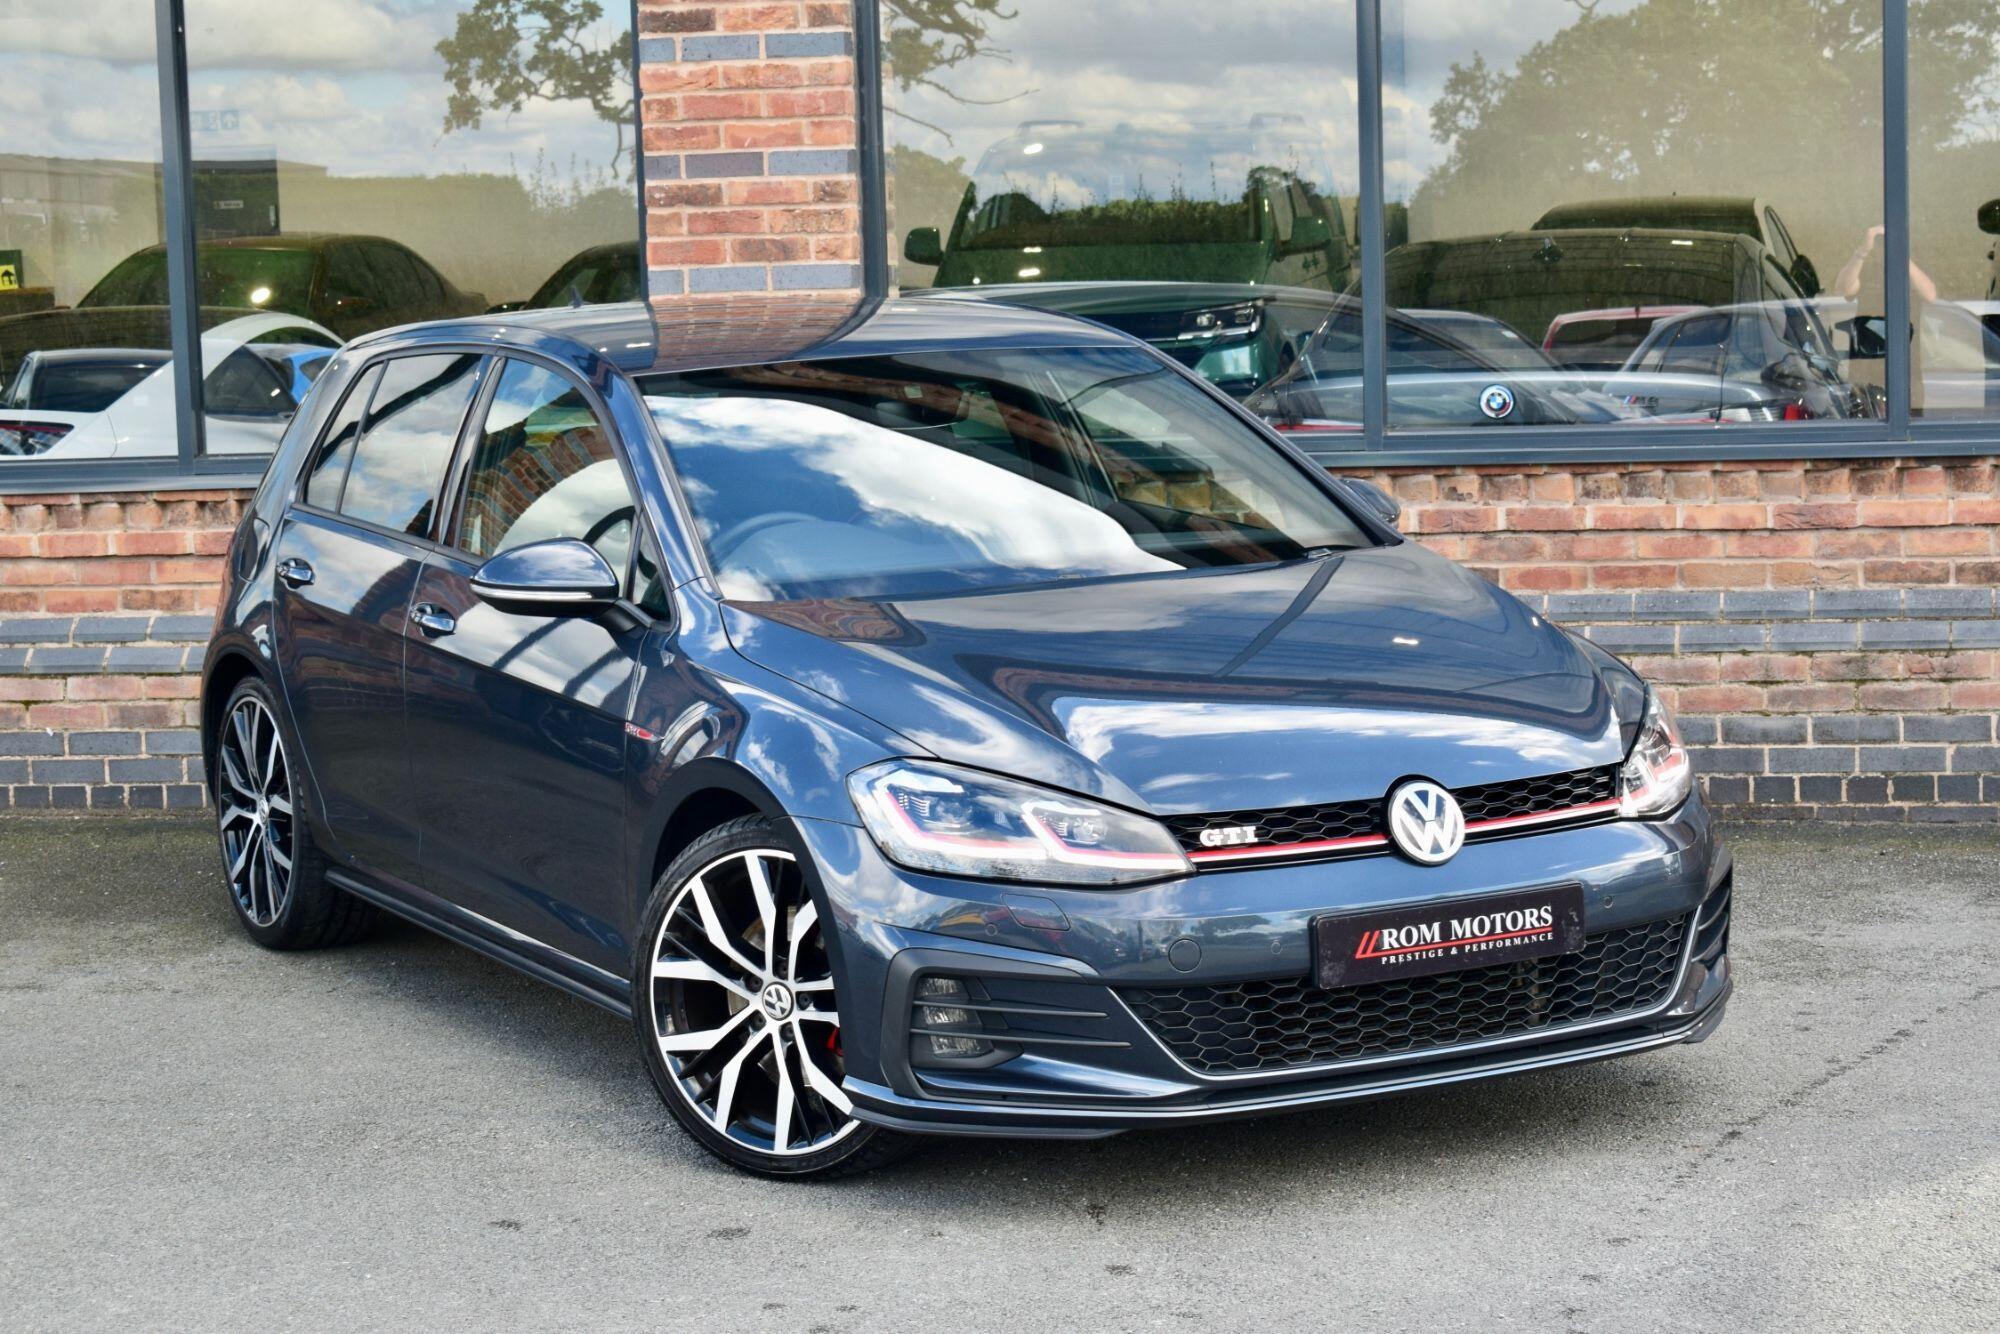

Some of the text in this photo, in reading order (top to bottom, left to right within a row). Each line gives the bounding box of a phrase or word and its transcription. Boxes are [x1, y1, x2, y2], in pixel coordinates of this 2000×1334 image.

[1200, 826, 1258, 847] GTI
[1390, 782, 1464, 862] VW
[1381, 905, 1553, 950] ROM MOTORS
[1381, 932, 1553, 965] PRESTIGE & PERFORMANCE
